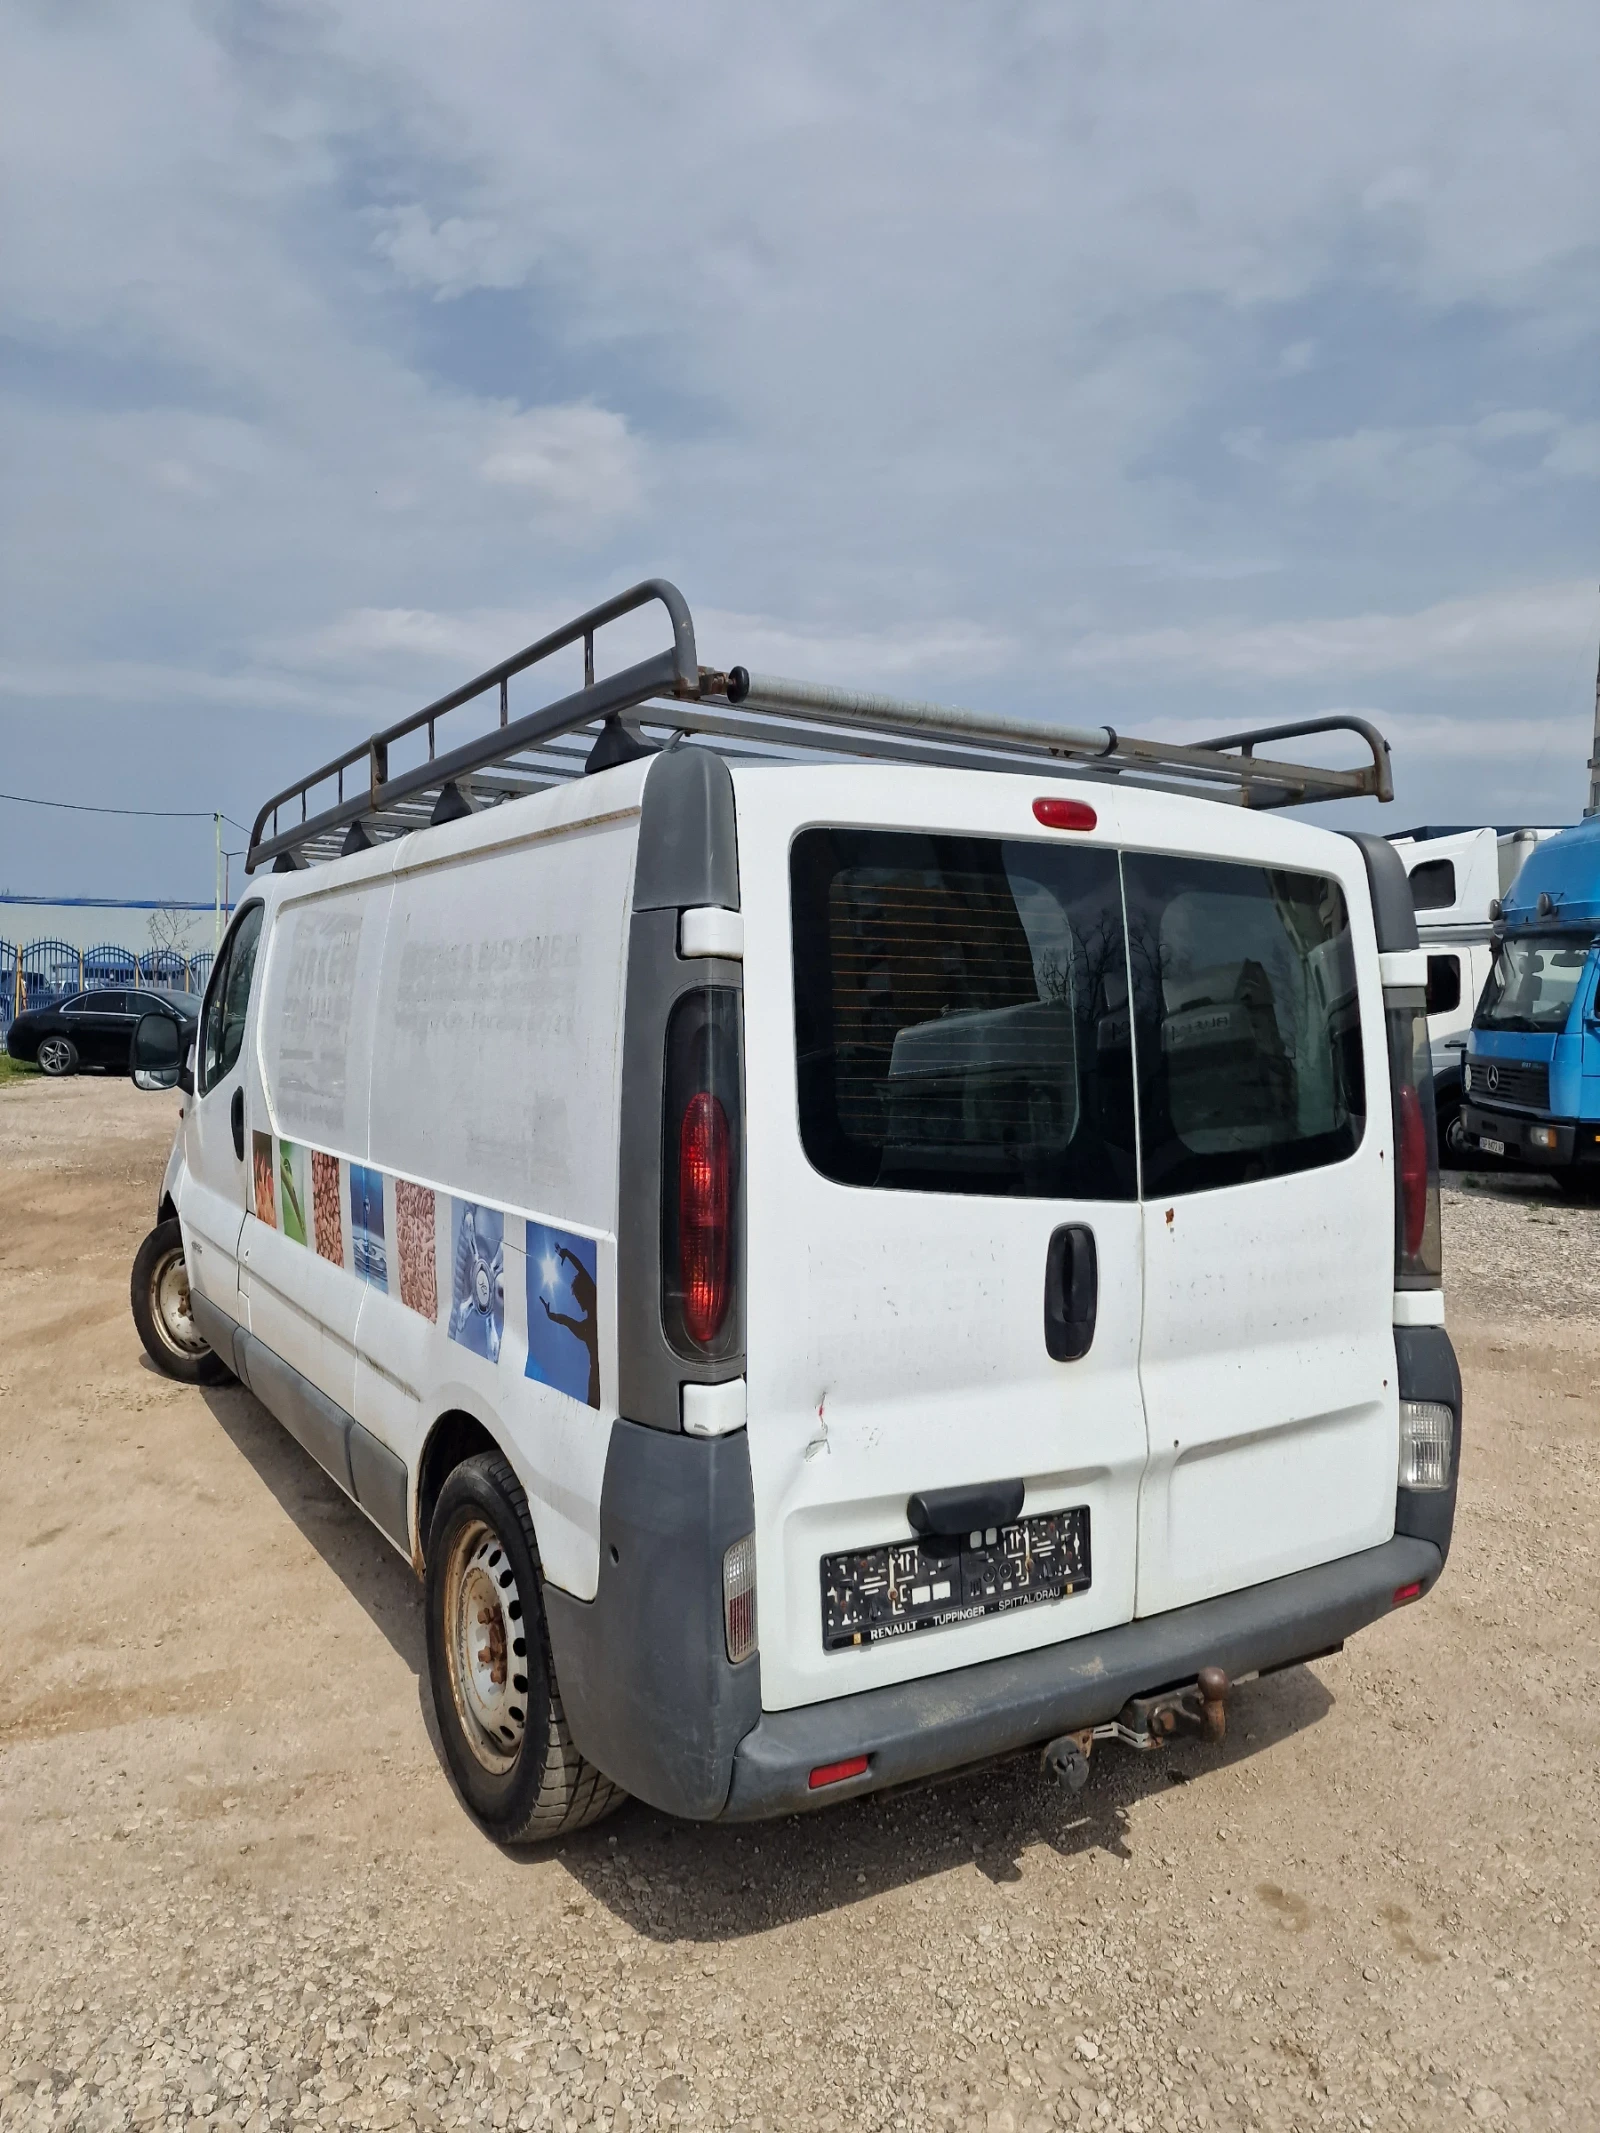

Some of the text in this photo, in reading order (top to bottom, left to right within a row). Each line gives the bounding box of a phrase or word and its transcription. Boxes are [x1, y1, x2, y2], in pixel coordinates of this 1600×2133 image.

[870, 1621, 918, 1640] RENAULT
[933, 1605, 985, 1626] TUPPINGER
[998, 1586, 1060, 1611] SPITTAL/DRAU
